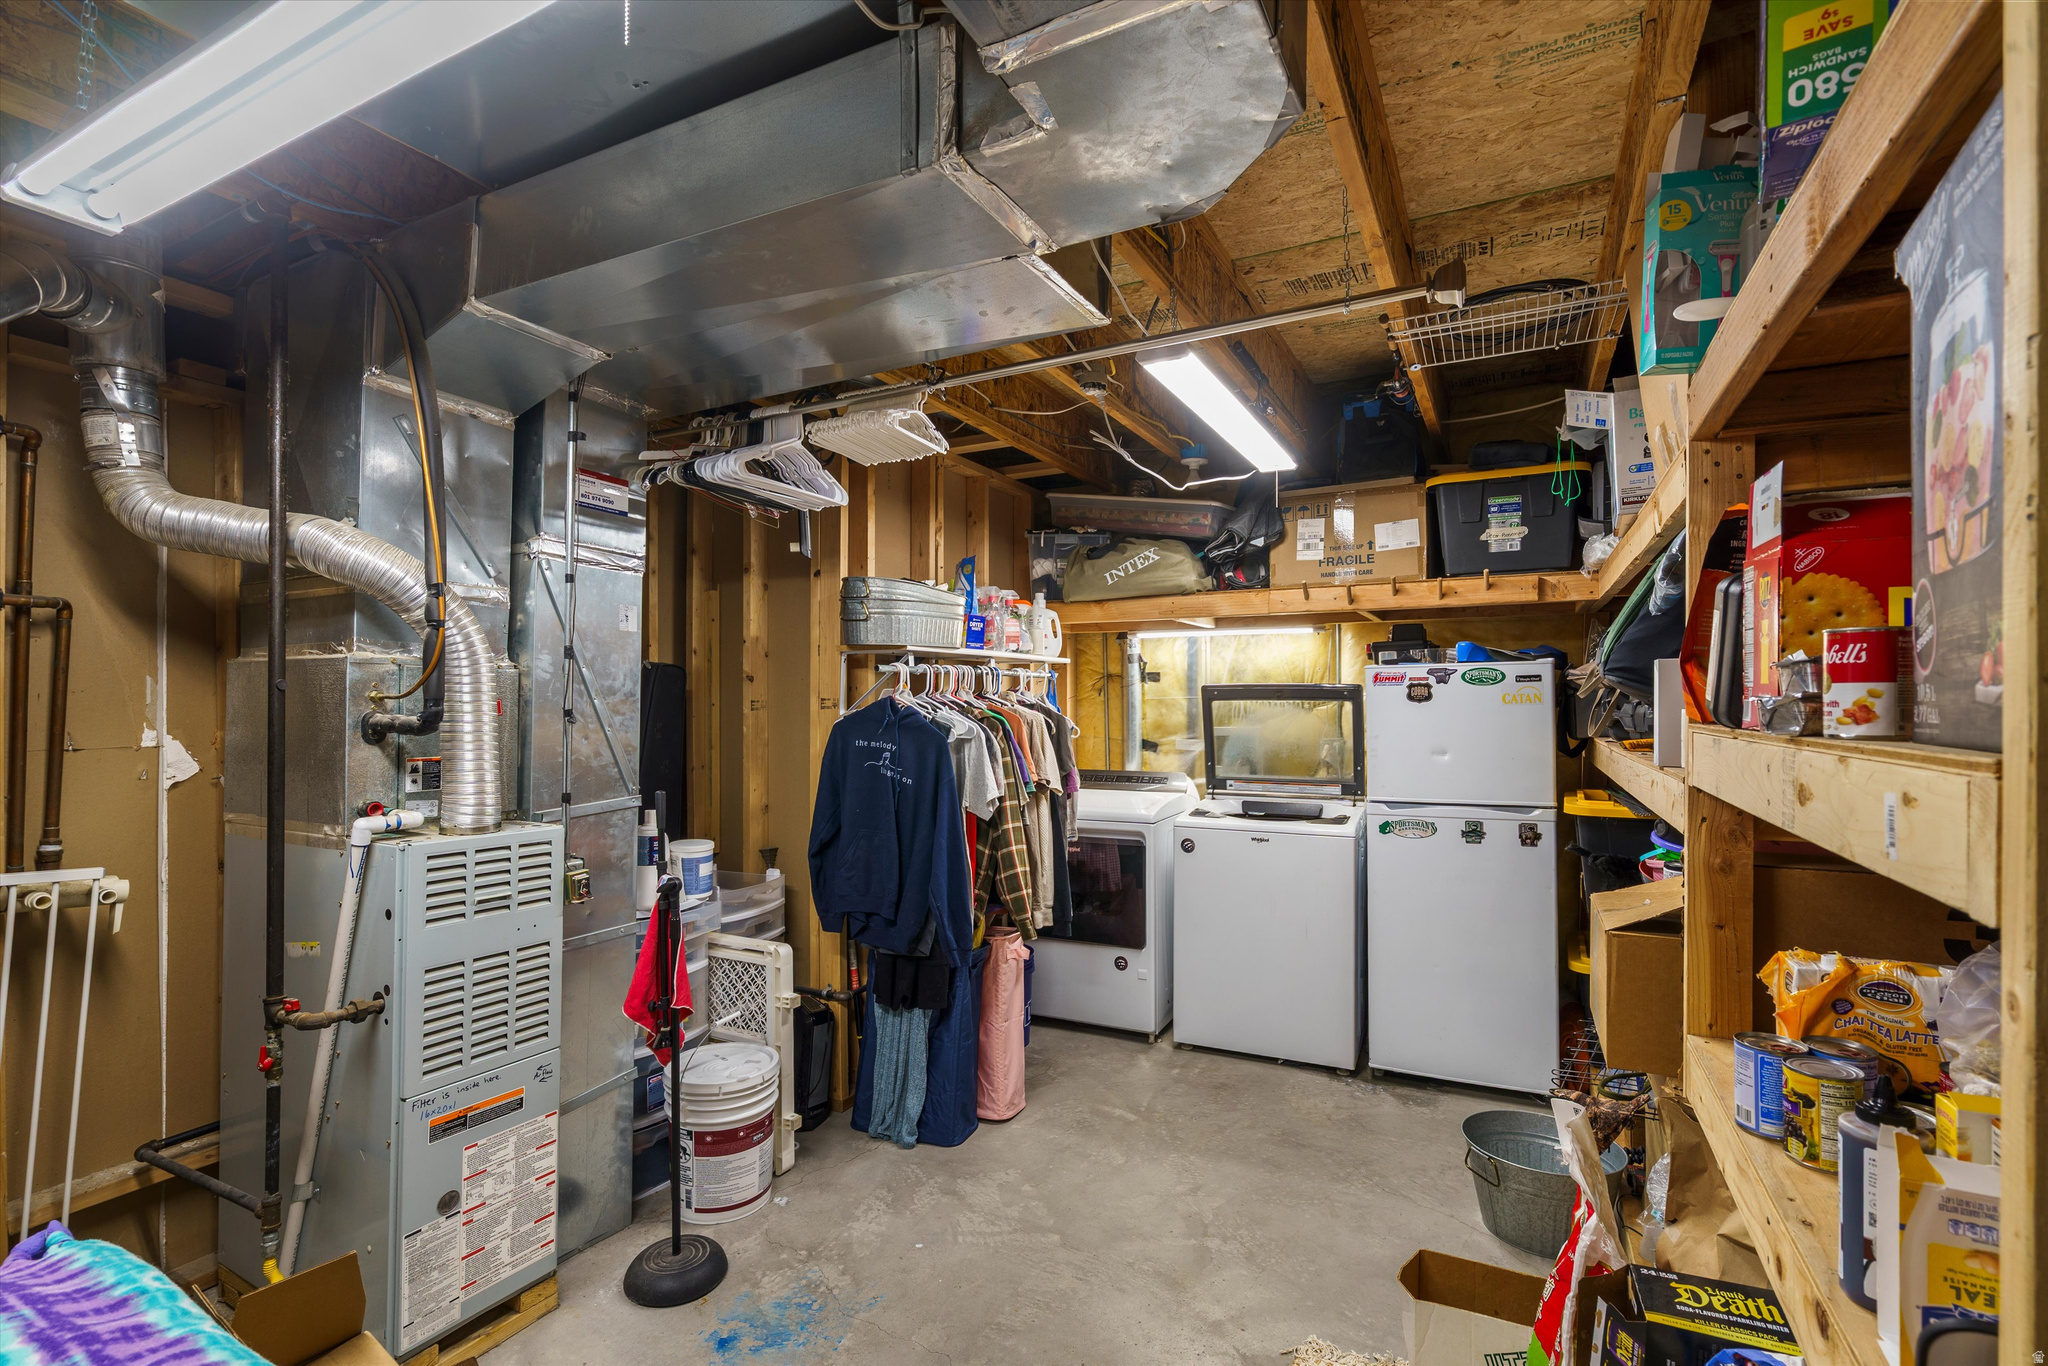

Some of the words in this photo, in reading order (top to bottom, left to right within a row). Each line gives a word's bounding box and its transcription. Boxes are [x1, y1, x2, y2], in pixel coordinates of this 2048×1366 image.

[1803, 15, 1854, 41] SAVE
[1812, 46, 1842, 61] BAGS
[1788, 46, 1868, 79] SANDWICH
[1787, 62, 1866, 107] 580
[1779, 116, 1837, 138] Ziploc
[1713, 171, 1745, 181] Venus
[1667, 203, 1682, 215] 15
[1478, 241, 1489, 256] APA
[1818, 510, 1844, 520] 18
[1104, 547, 1160, 585] INTEX
[1318, 554, 1375, 567] FRAGILE
[1797, 548, 1821, 570] NABISCO
[1320, 570, 1341, 578] HANDLE
[1825, 643, 1868, 664] bell's
[1502, 692, 1542, 705] CATAN
[1826, 699, 1839, 708] with
[855, 739, 868, 747] the
[870, 741, 897, 751] melody
[902, 777, 912, 785] on
[1390, 820, 1438, 835] SPORTSMAN'S
[1250, 836, 1270, 844] Whirlpool
[1862, 988, 1907, 1000] oregon
[1865, 1010, 1876, 1018] THE
[1834, 1015, 1865, 1030] CHAI
[1867, 1018, 1893, 1042] TEA
[1896, 1028, 1940, 1046] LATTE
[1853, 1027, 1877, 1041] ORGANIC
[1886, 1043, 1907, 1051] GLUTEN
[412, 1096, 436, 1112] Filter
[442, 1091, 450, 1100] is
[457, 1081, 480, 1094] inside
[1938, 1203, 1959, 1215] BOTTLES
[1960, 1207, 1980, 1219] SQUEEZE
[1943, 1276, 1996, 1293] ONNAISE
[1705, 1287, 1746, 1301] Liquid
[1949, 1285, 1996, 1308] EAL
[1670, 1281, 1785, 1324] Death
[1676, 1304, 1729, 1320] SODA-FLAVORED
[1729, 1315, 1766, 1328] SPARKLING
[1766, 1323, 1790, 1333] WATER
[1694, 1318, 1721, 1329] KILLER
[1721, 1324, 1758, 1337] CLASSICS
[1758, 1331, 1780, 1342] PACK
